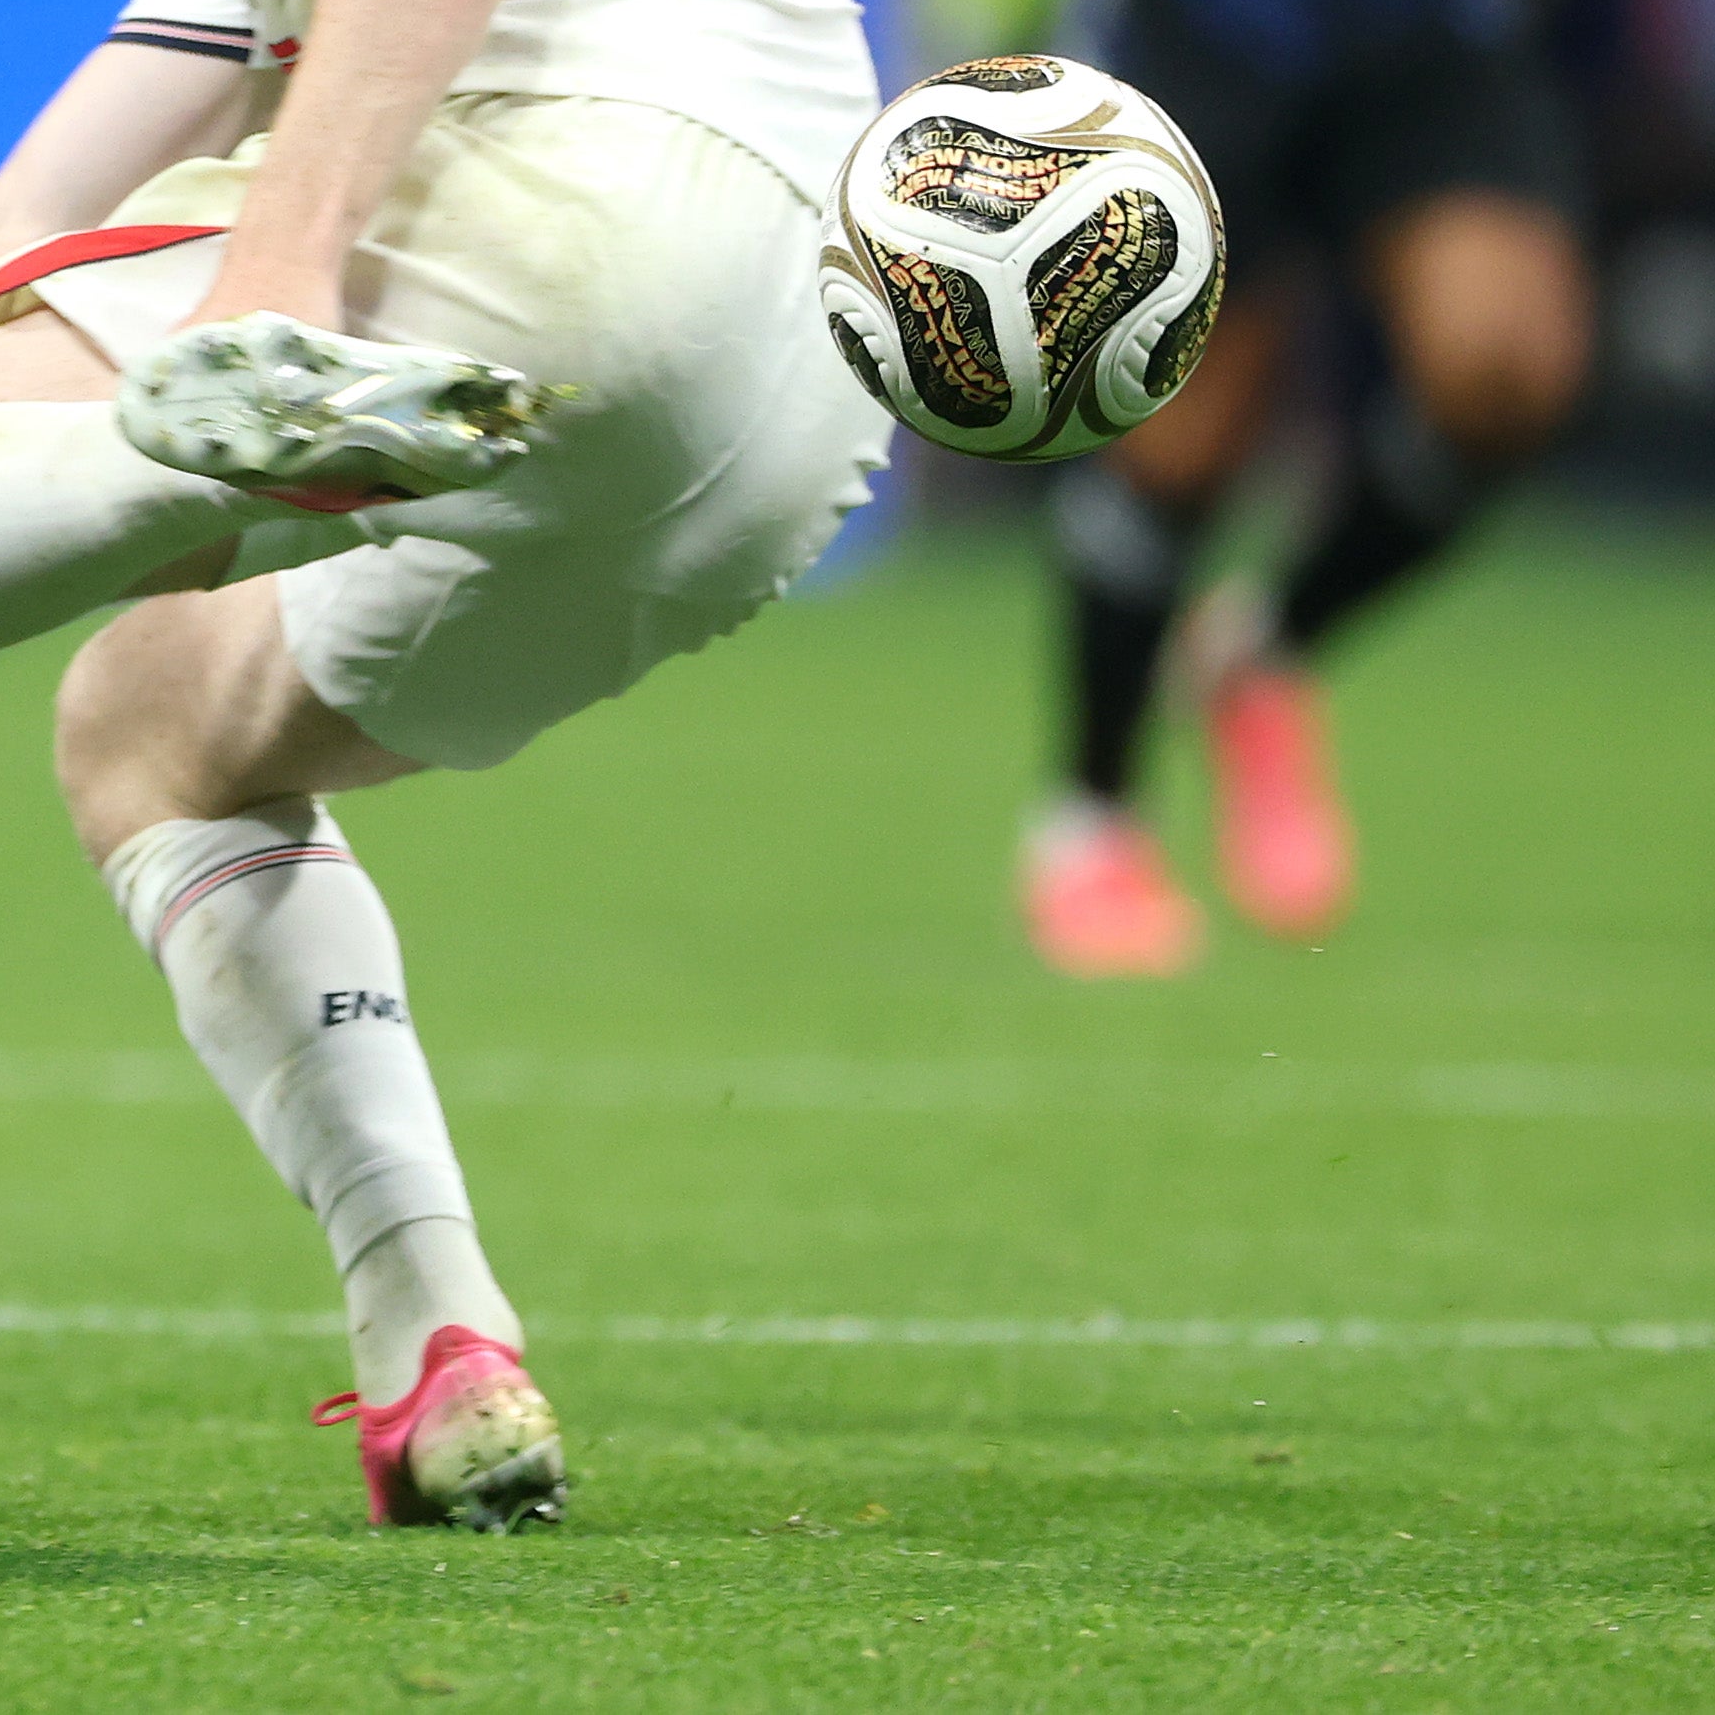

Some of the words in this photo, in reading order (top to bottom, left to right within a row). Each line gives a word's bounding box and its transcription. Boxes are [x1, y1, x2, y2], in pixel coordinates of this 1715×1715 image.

[952, 171, 1060, 201] JERSEY
[964, 149, 1060, 178] YORK
[1036, 195, 1126, 347] ATLANTA
[1113, 204, 1144, 271] NEW
[885, 264, 993, 405] DALLAS
[898, 252, 1010, 395] MIAMI
